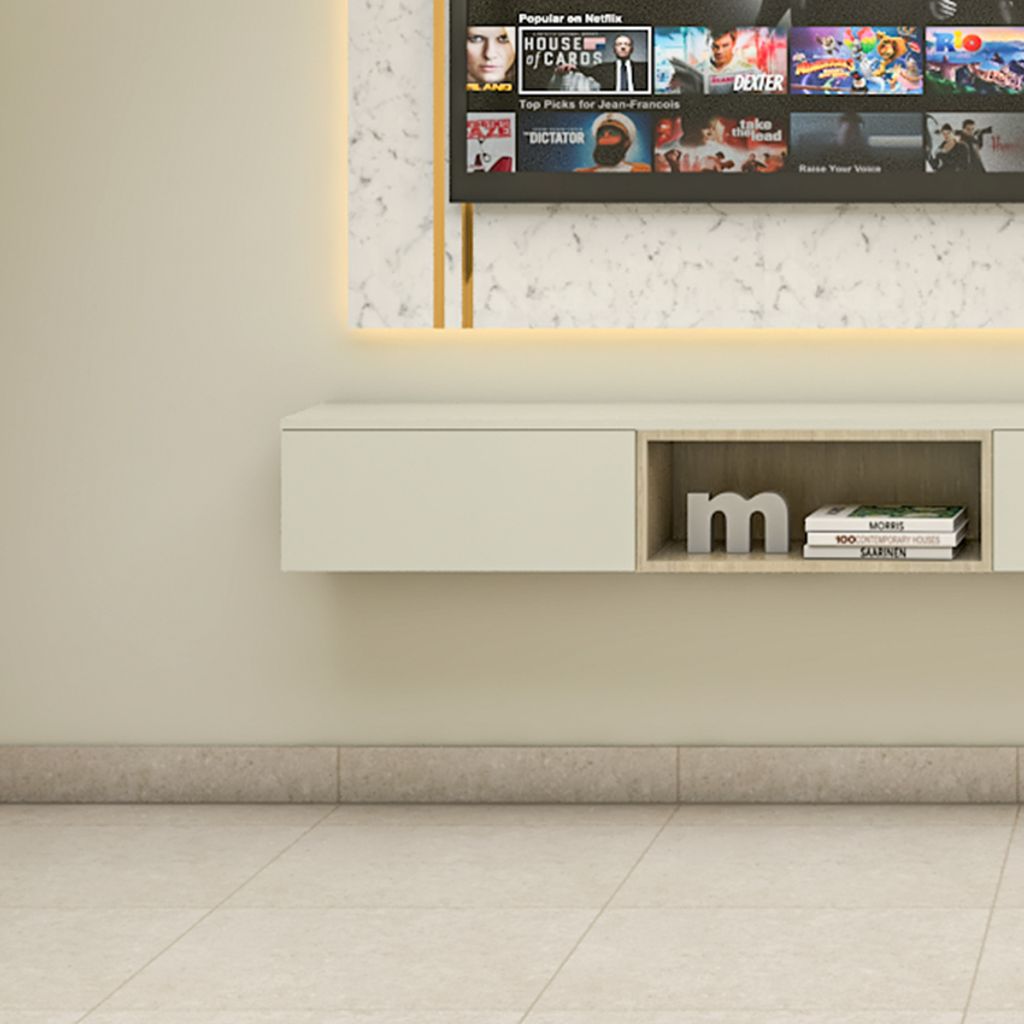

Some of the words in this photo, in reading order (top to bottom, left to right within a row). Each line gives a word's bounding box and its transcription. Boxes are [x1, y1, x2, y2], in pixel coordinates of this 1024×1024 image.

[519, 14, 564, 25] Popular
[585, 13, 623, 23] Netflix
[524, 37, 582, 51] HOUSE
[526, 51, 541, 70] of
[544, 51, 603, 66] CARDS
[733, 74, 784, 92] DEXTER
[519, 99, 541, 110] Top
[544, 99, 576, 109] Picks
[579, 99, 595, 109] for
[598, 99, 681, 109] Jean-Francois
[739, 118, 773, 131] take
[529, 131, 585, 144] DICTATOR
[752, 129, 782, 142] lead
[799, 164, 827, 172] Raise
[830, 164, 852, 172] Your
[855, 164, 881, 172] Voice
[687, 492, 789, 554] m
[869, 521, 904, 531] MORRIS
[836, 535, 857, 544] 100
[912, 536, 940, 544] HOUSES
[860, 547, 906, 558] SAARINEN
